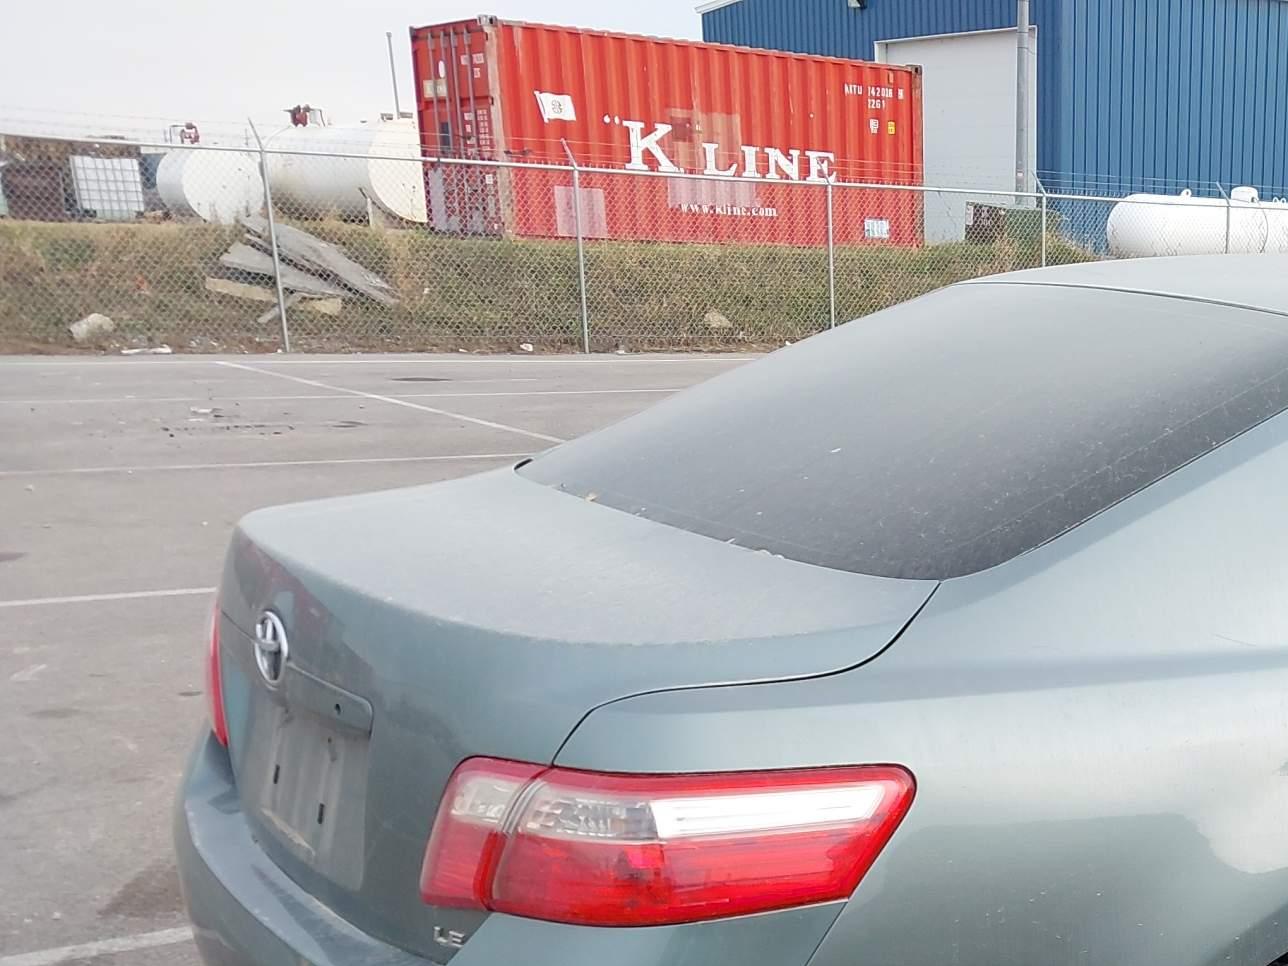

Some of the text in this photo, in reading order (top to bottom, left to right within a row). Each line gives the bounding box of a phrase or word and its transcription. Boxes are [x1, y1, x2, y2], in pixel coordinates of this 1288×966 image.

[702, 142, 837, 183] LINE
[681, 203, 778, 217] www.kline.com
[432, 926, 466, 949] LE
